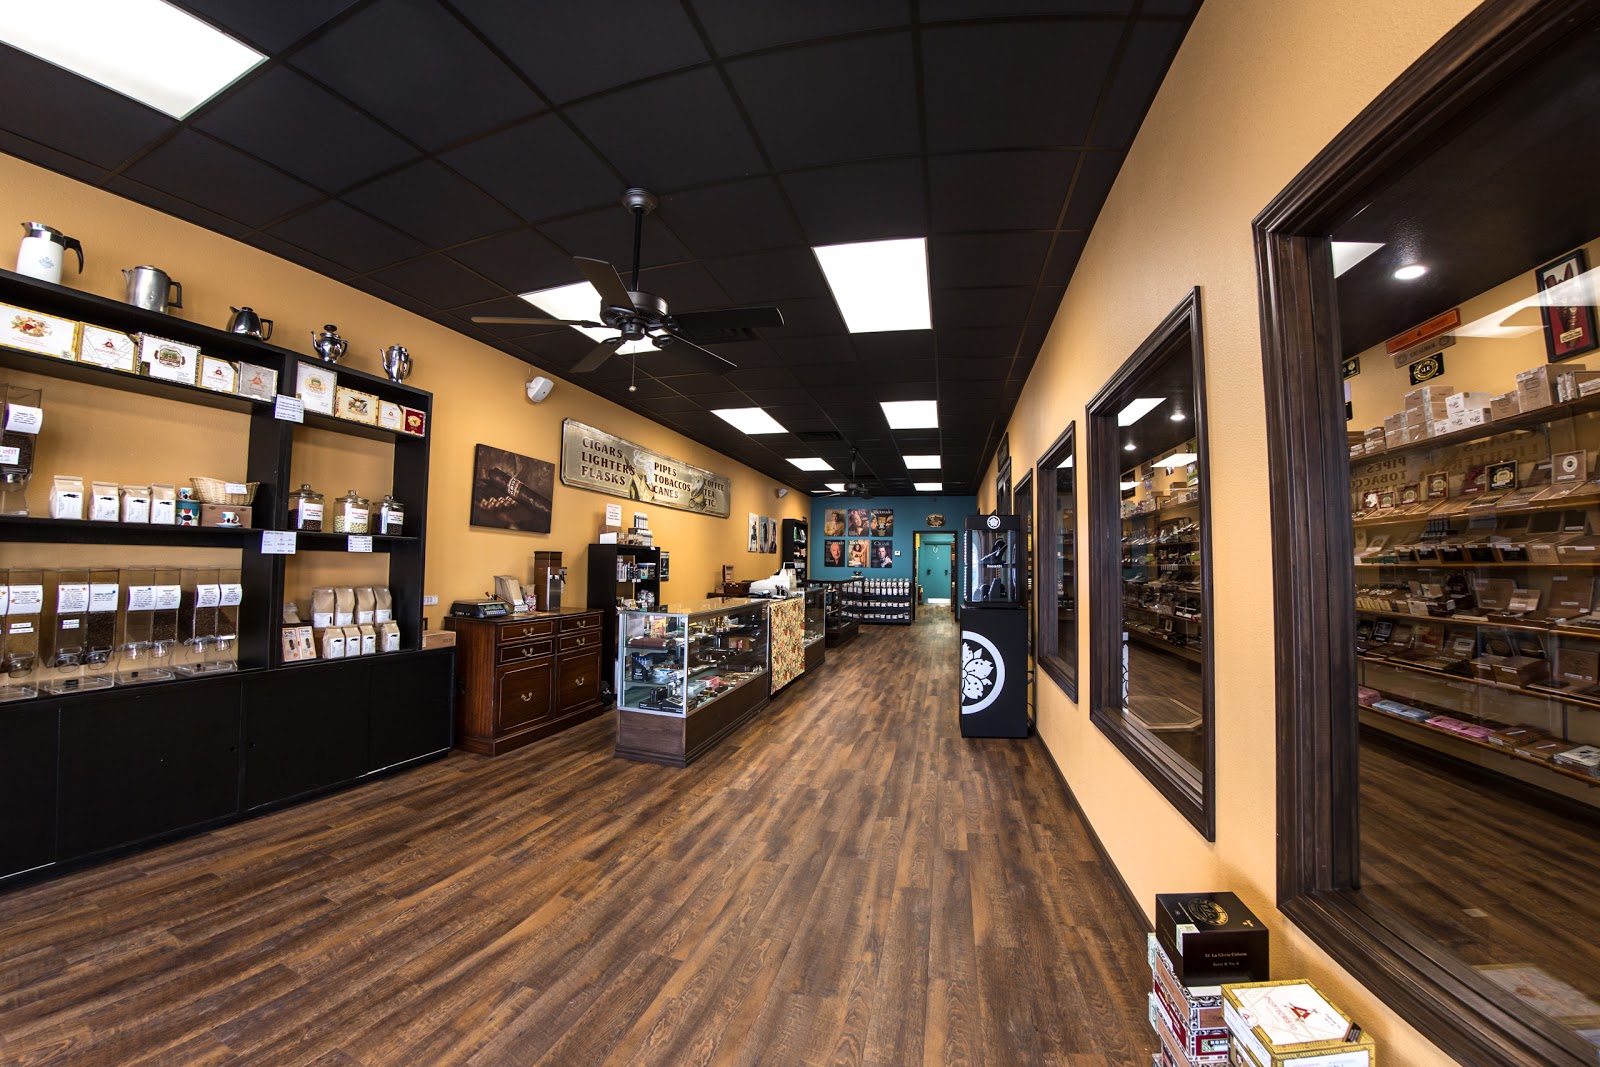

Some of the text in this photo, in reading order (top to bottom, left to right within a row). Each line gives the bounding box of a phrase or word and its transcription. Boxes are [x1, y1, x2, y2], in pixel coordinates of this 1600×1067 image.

[582, 437, 623, 459] CIGARS
[581, 451, 635, 476] LIGHTERS
[654, 462, 677, 477] PIPES
[581, 465, 626, 486] FLASKS
[653, 473, 691, 492] TOBACCOS
[653, 485, 679, 499] CANES
[703, 479, 725, 491] COFFEE
[703, 488, 715, 498] TEA
